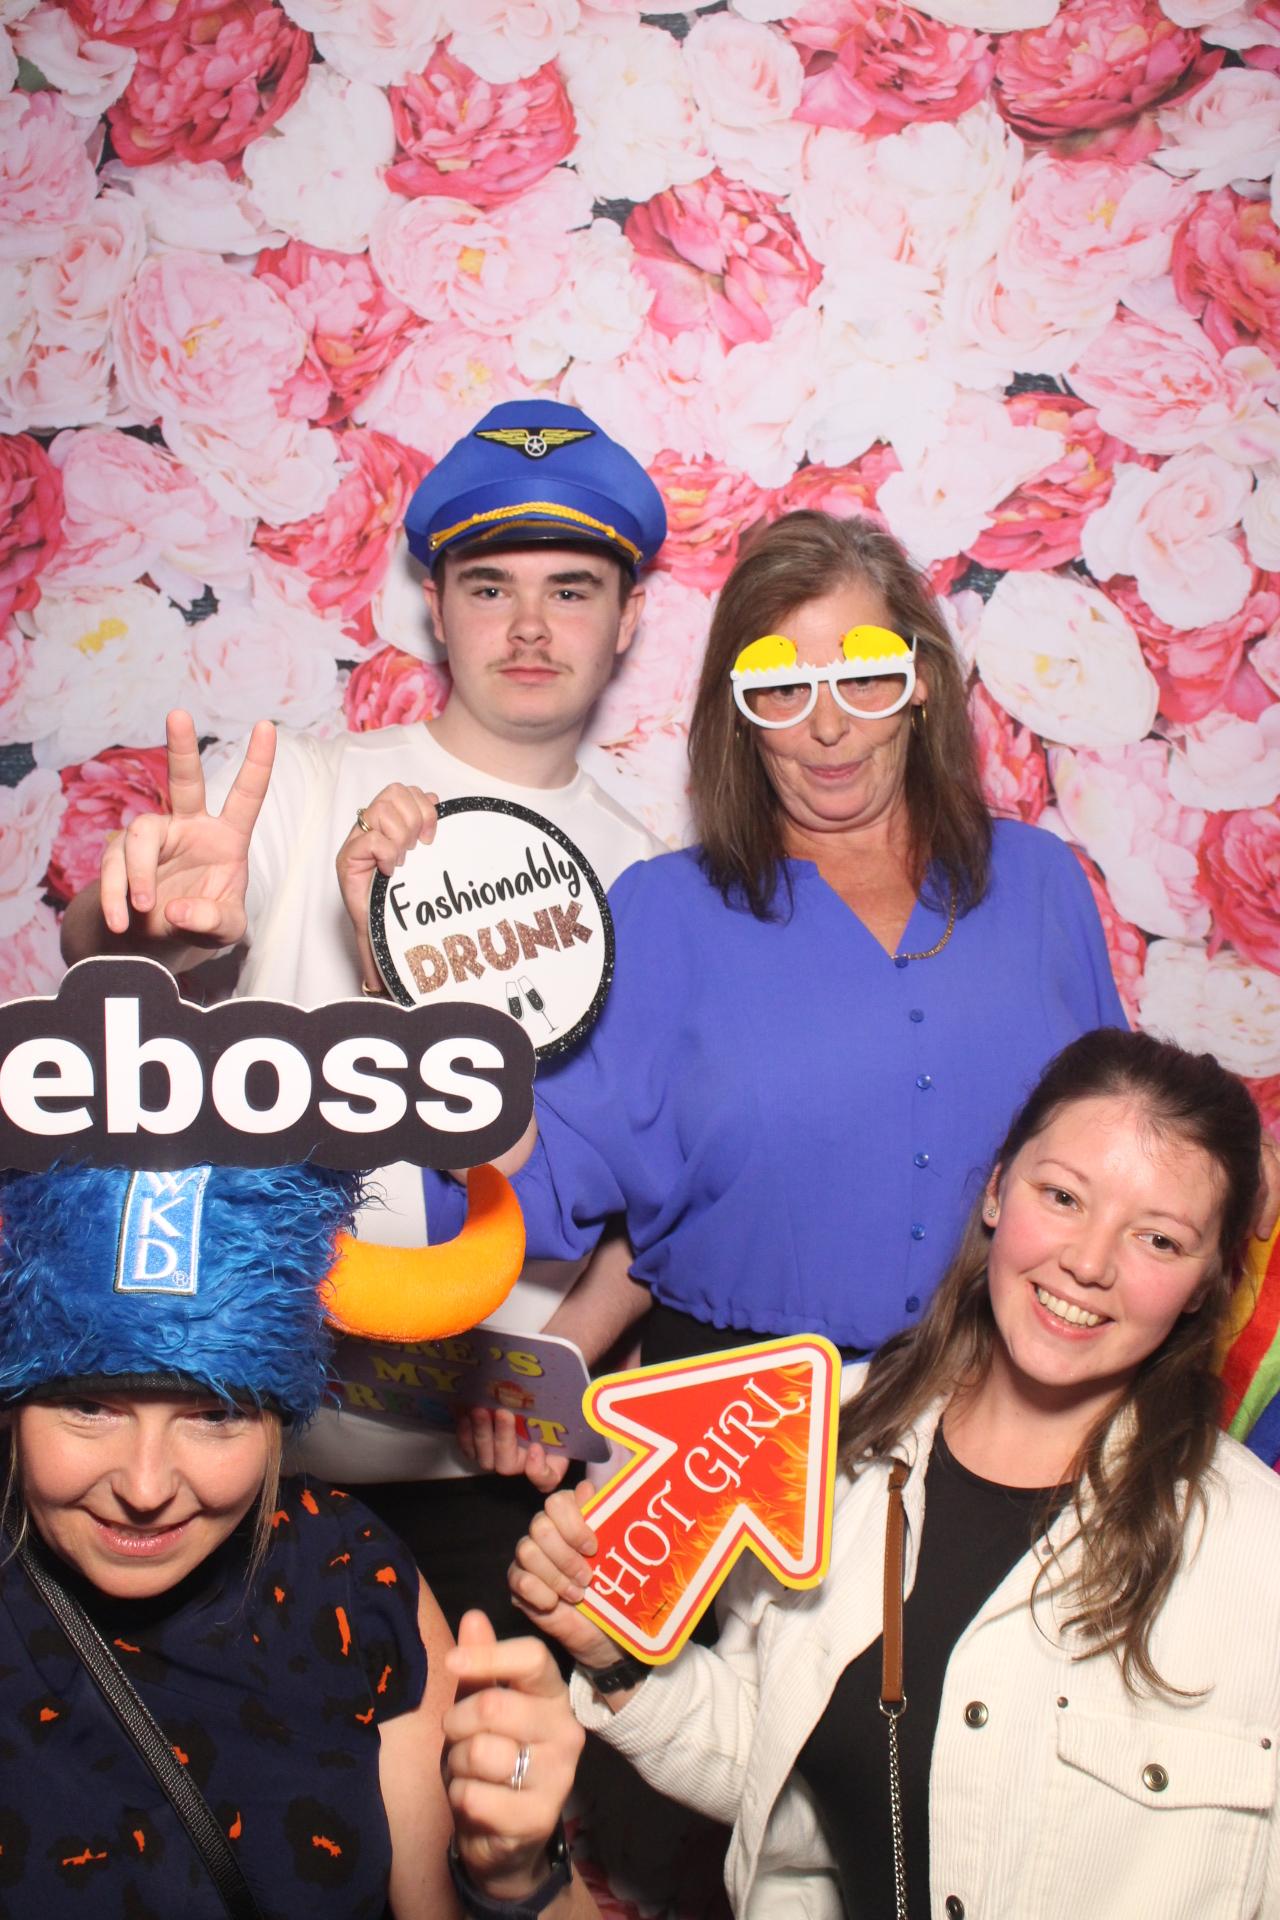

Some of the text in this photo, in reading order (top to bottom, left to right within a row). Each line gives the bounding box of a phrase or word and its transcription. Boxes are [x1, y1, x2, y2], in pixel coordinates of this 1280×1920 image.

[389, 842, 581, 931] Fashionably
[404, 900, 593, 995] DRUNK
[0, 997, 505, 1136] eboss
[368, 1355, 463, 1393] MY
[592, 1377, 809, 1605] HOT GIRL
